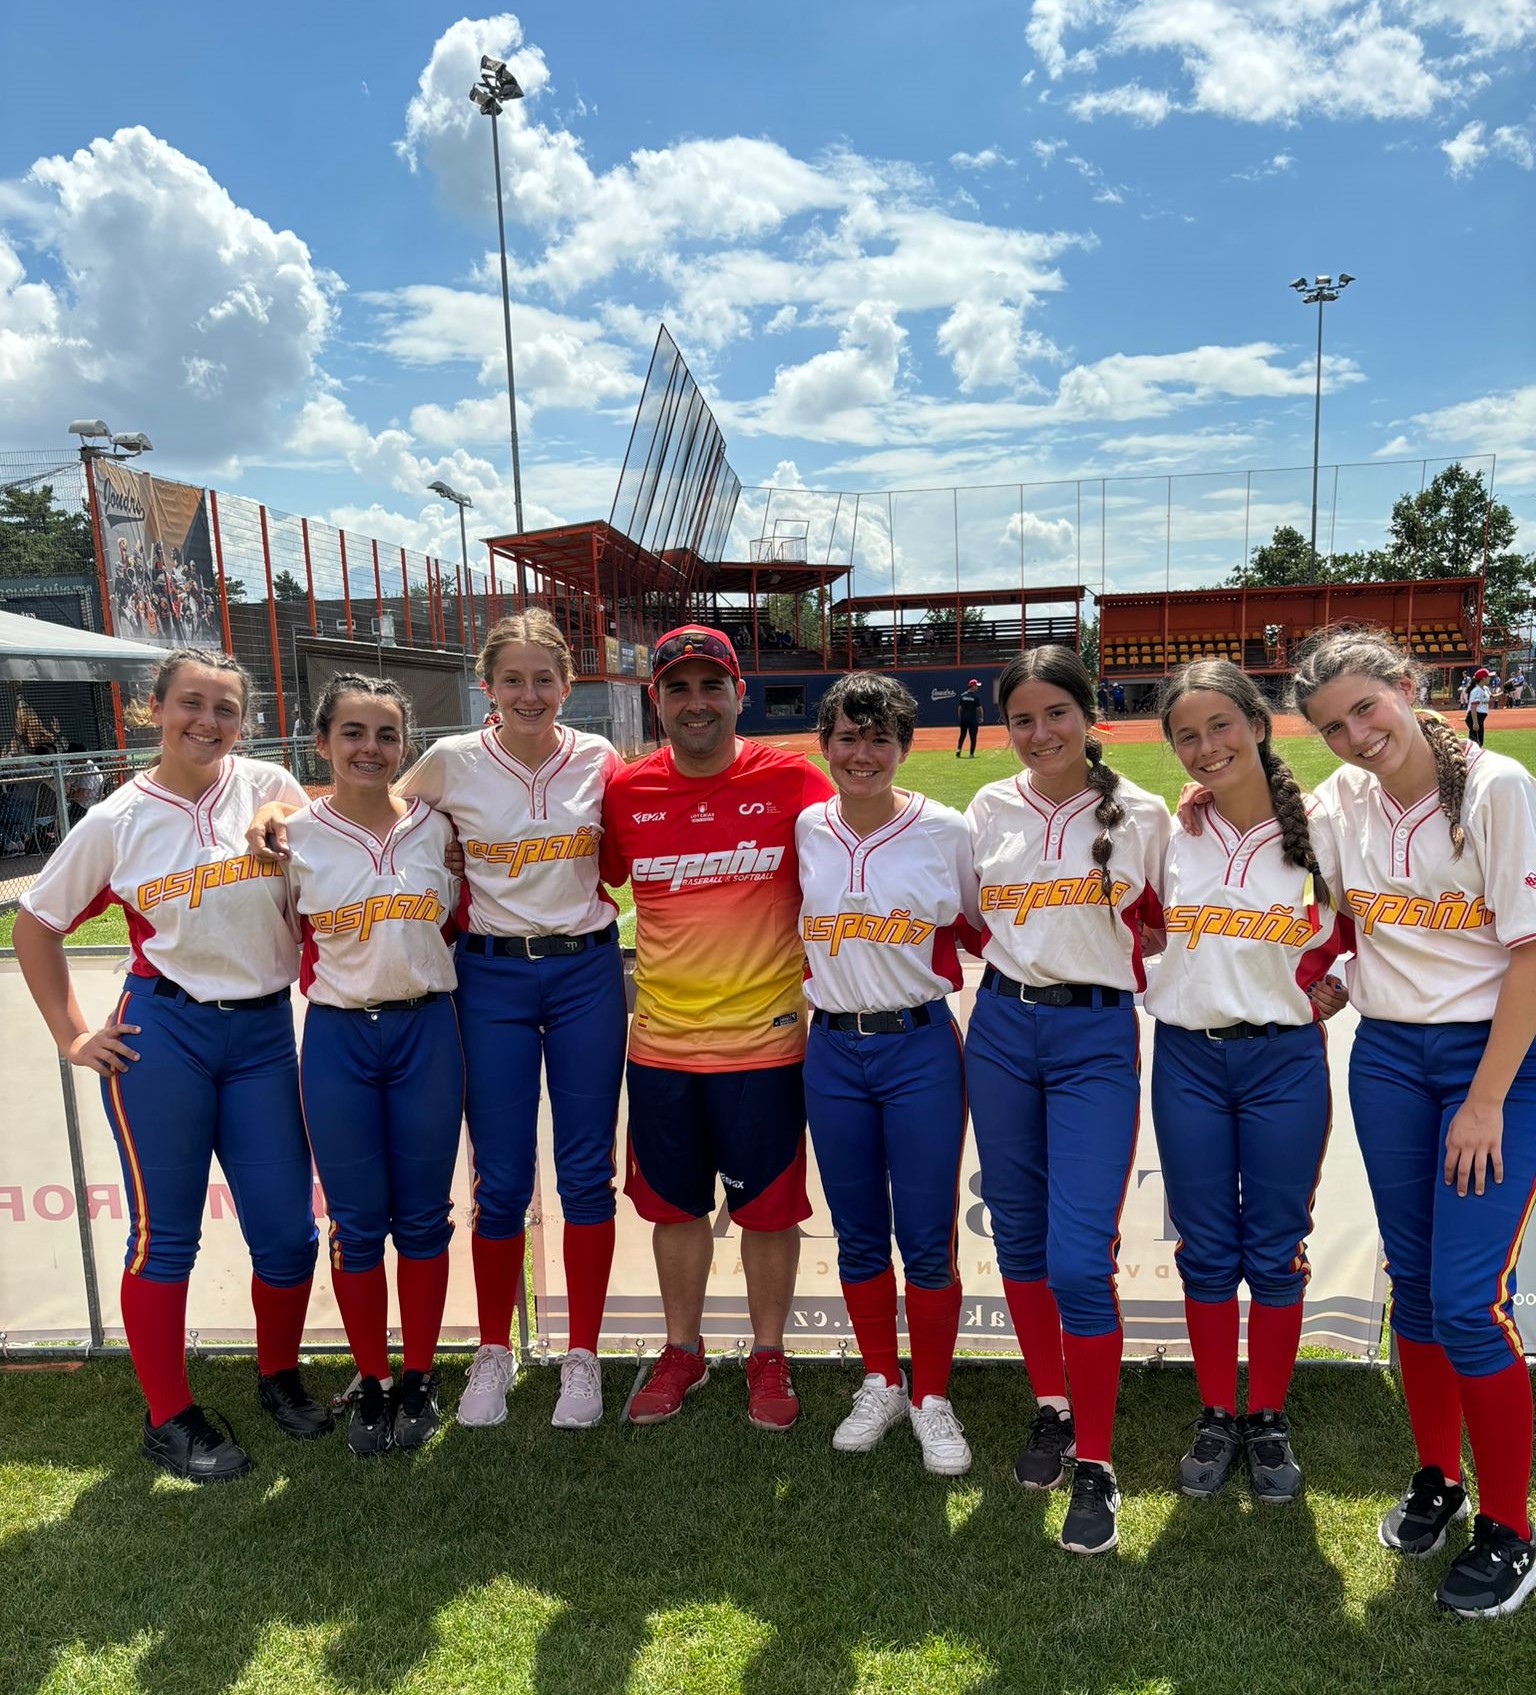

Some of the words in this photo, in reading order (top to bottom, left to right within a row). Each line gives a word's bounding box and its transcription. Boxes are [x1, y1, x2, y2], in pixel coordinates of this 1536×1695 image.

[631, 840, 786, 891] españa
[682, 876, 722, 886] BASEBALL
[733, 872, 774, 881] SOFTBALL
[310, 887, 446, 942] españ
[1345, 888, 1495, 935] spaña
